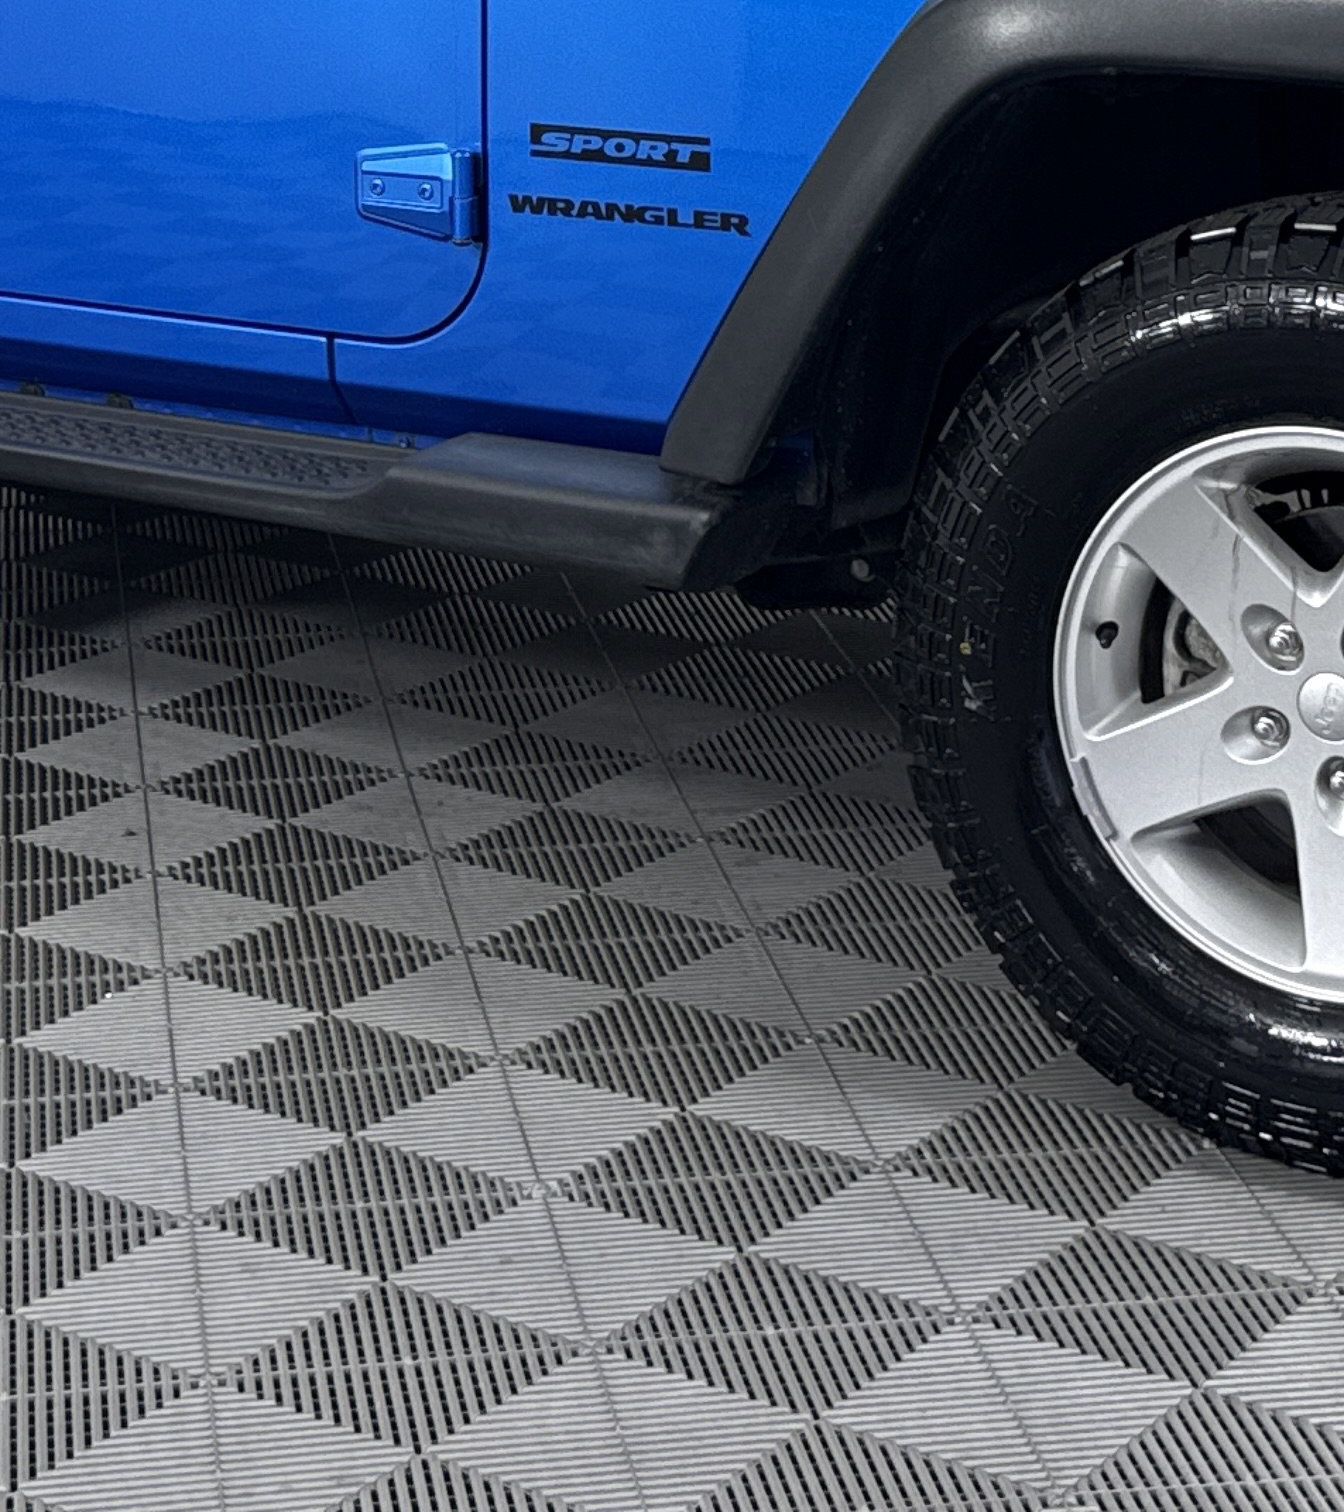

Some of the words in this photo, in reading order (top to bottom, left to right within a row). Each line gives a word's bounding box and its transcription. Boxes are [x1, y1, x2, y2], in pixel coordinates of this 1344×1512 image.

[539, 131, 711, 164] SPORT
[508, 193, 752, 238] WRANGLER
[960, 484, 1042, 723] KENDA
